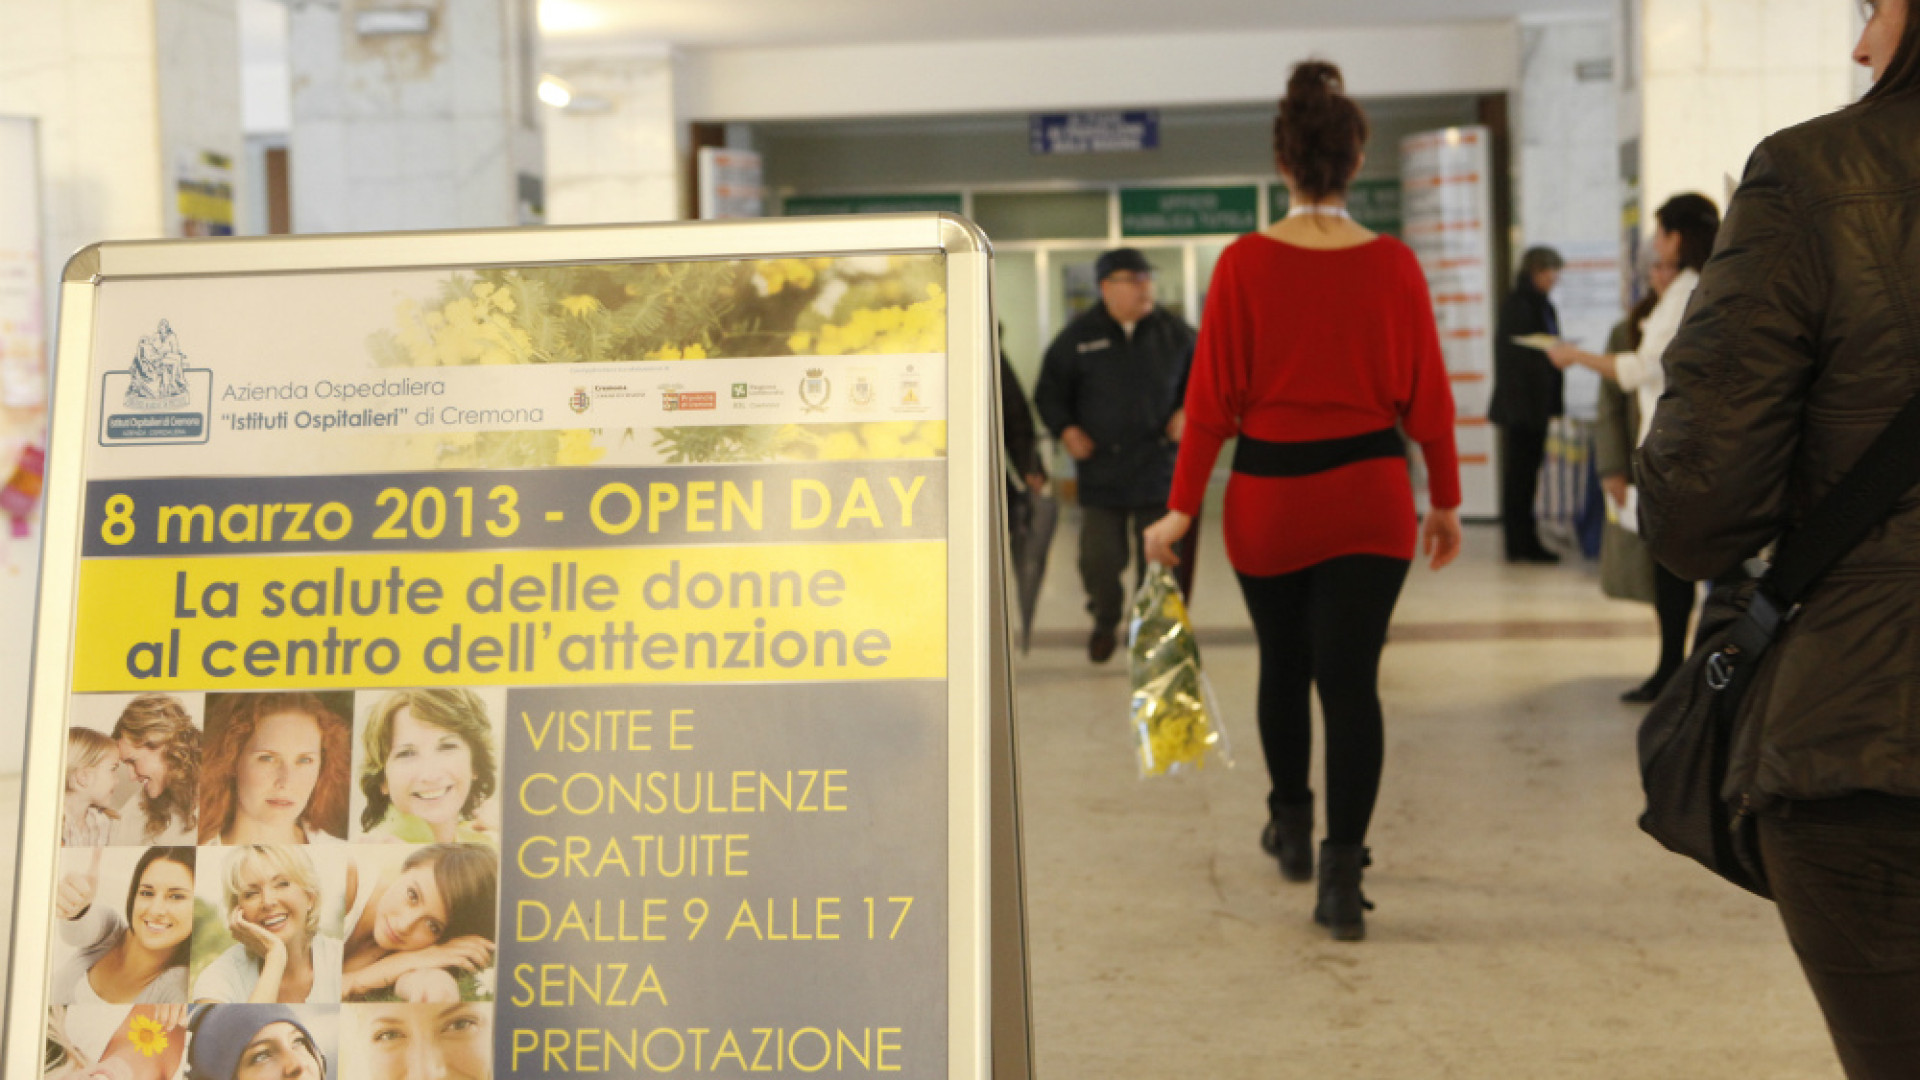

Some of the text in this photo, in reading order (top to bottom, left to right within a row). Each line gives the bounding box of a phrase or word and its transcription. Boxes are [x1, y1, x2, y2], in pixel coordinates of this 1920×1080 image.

[222, 378, 446, 402] Azienda Ospedaliera
[221, 406, 544, 432] “Istituti Ospitalieri” di Cremona
[100, 475, 927, 546] 8 marzo 2013 - OPEN DAY
[174, 559, 846, 618] La salute delle donne
[126, 617, 892, 679] al centro dell’attenzione
[521, 709, 695, 753] VISITE E
[519, 769, 848, 816] CONSULENZE
[517, 834, 750, 879] GRATUITE
[516, 896, 914, 942] DALLE 9 ALLE 17
[511, 963, 668, 1008] SENZA
[511, 1026, 902, 1073] PRENOTAZIONE
